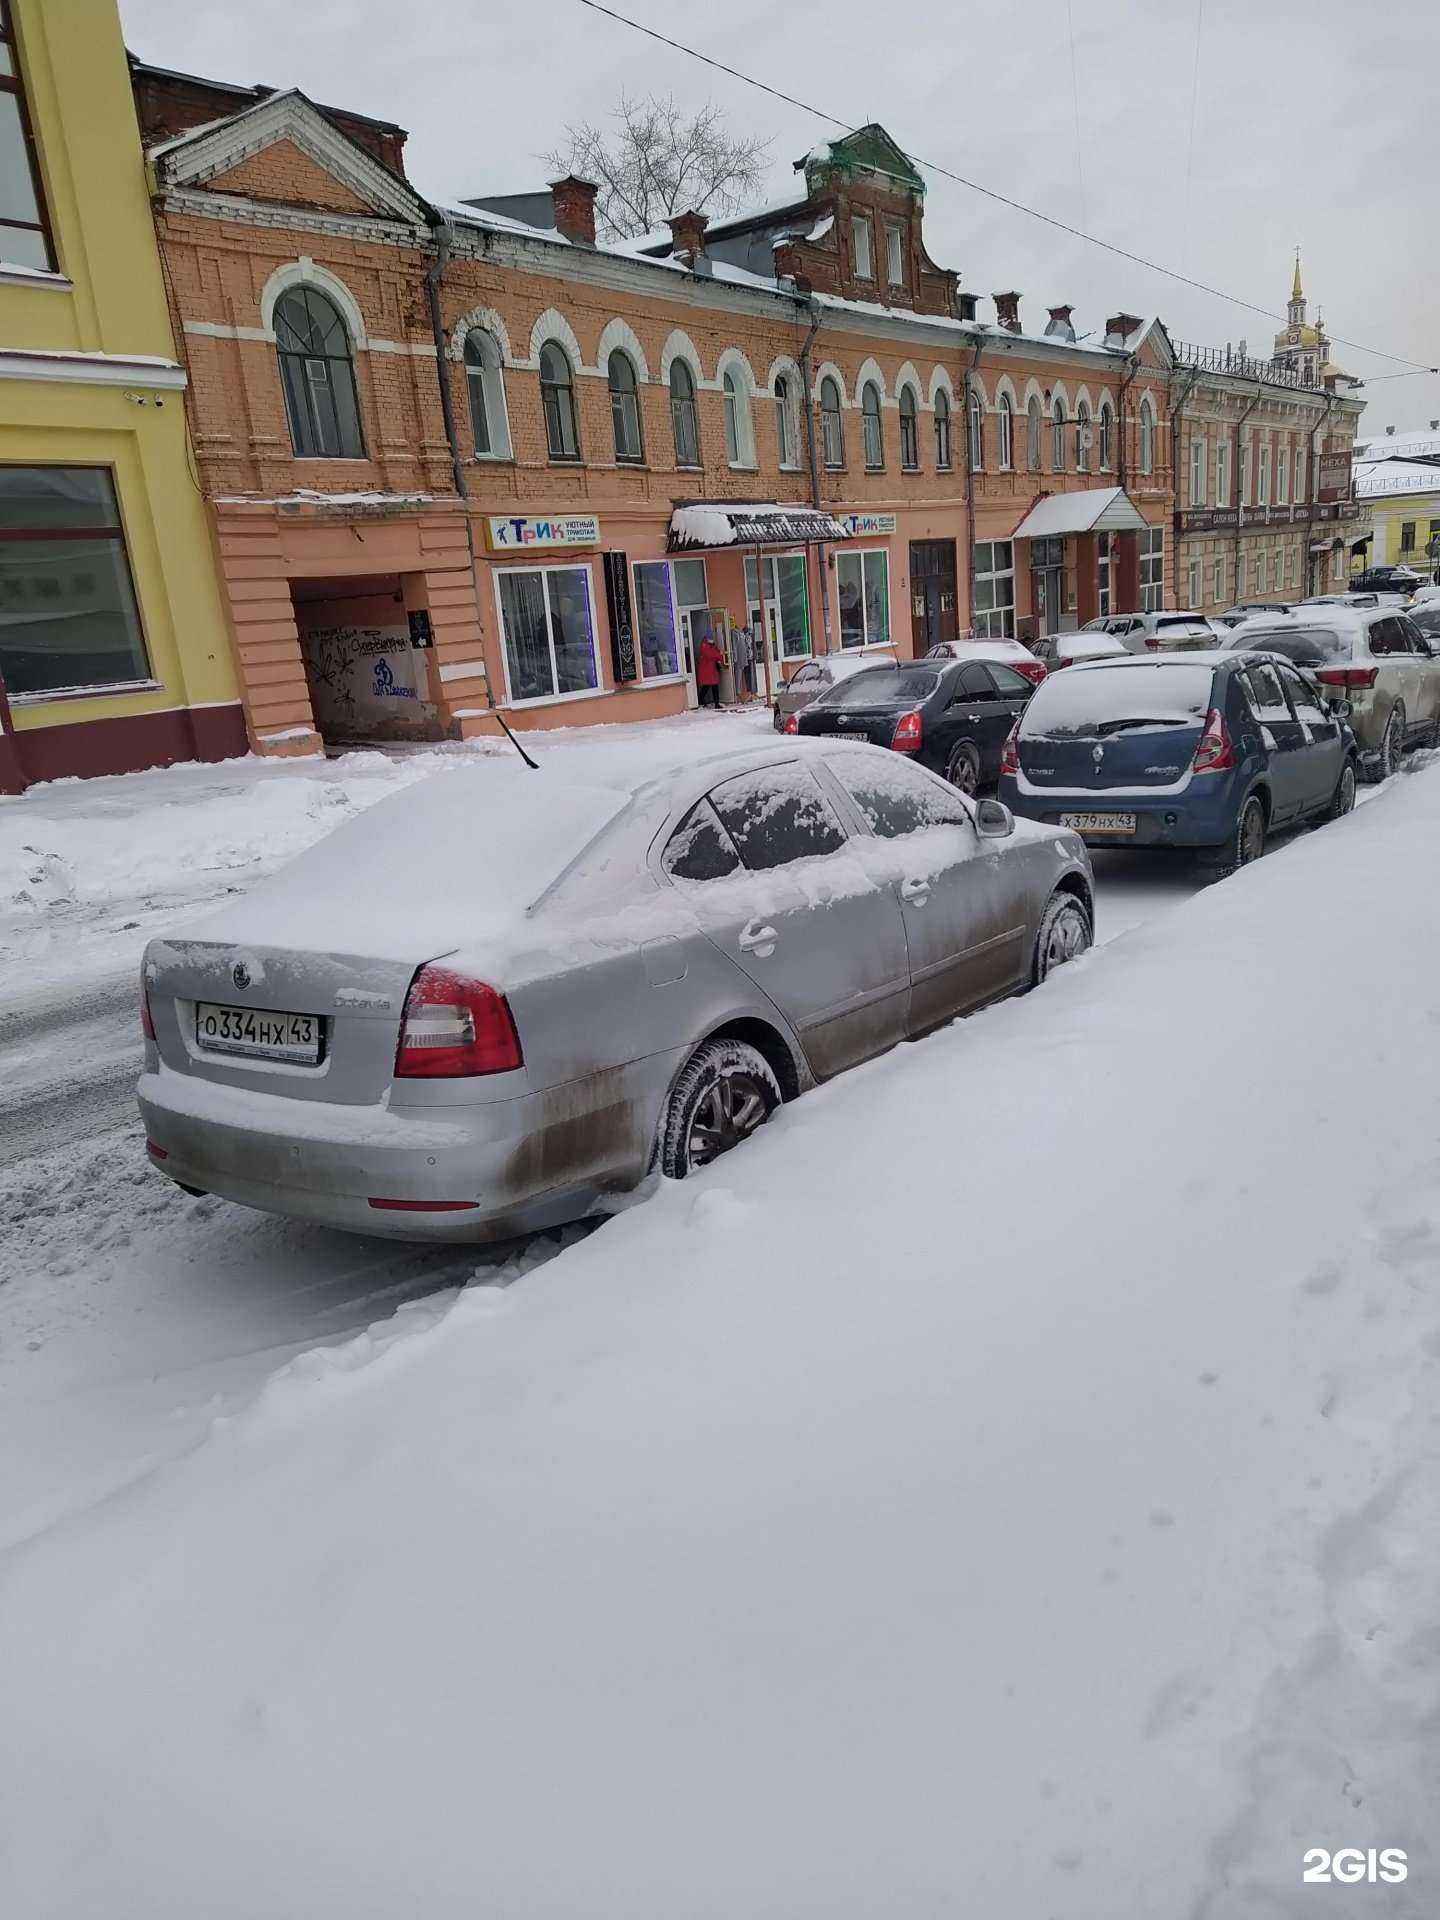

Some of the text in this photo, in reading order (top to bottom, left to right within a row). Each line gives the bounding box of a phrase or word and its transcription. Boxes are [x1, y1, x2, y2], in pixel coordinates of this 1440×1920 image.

[1320, 457, 1346, 469] МЕХА
[565, 519, 595, 529] УЮТНЫЙ
[1118, 815, 1132, 825] 43
[291, 1017, 313, 1043] 43
